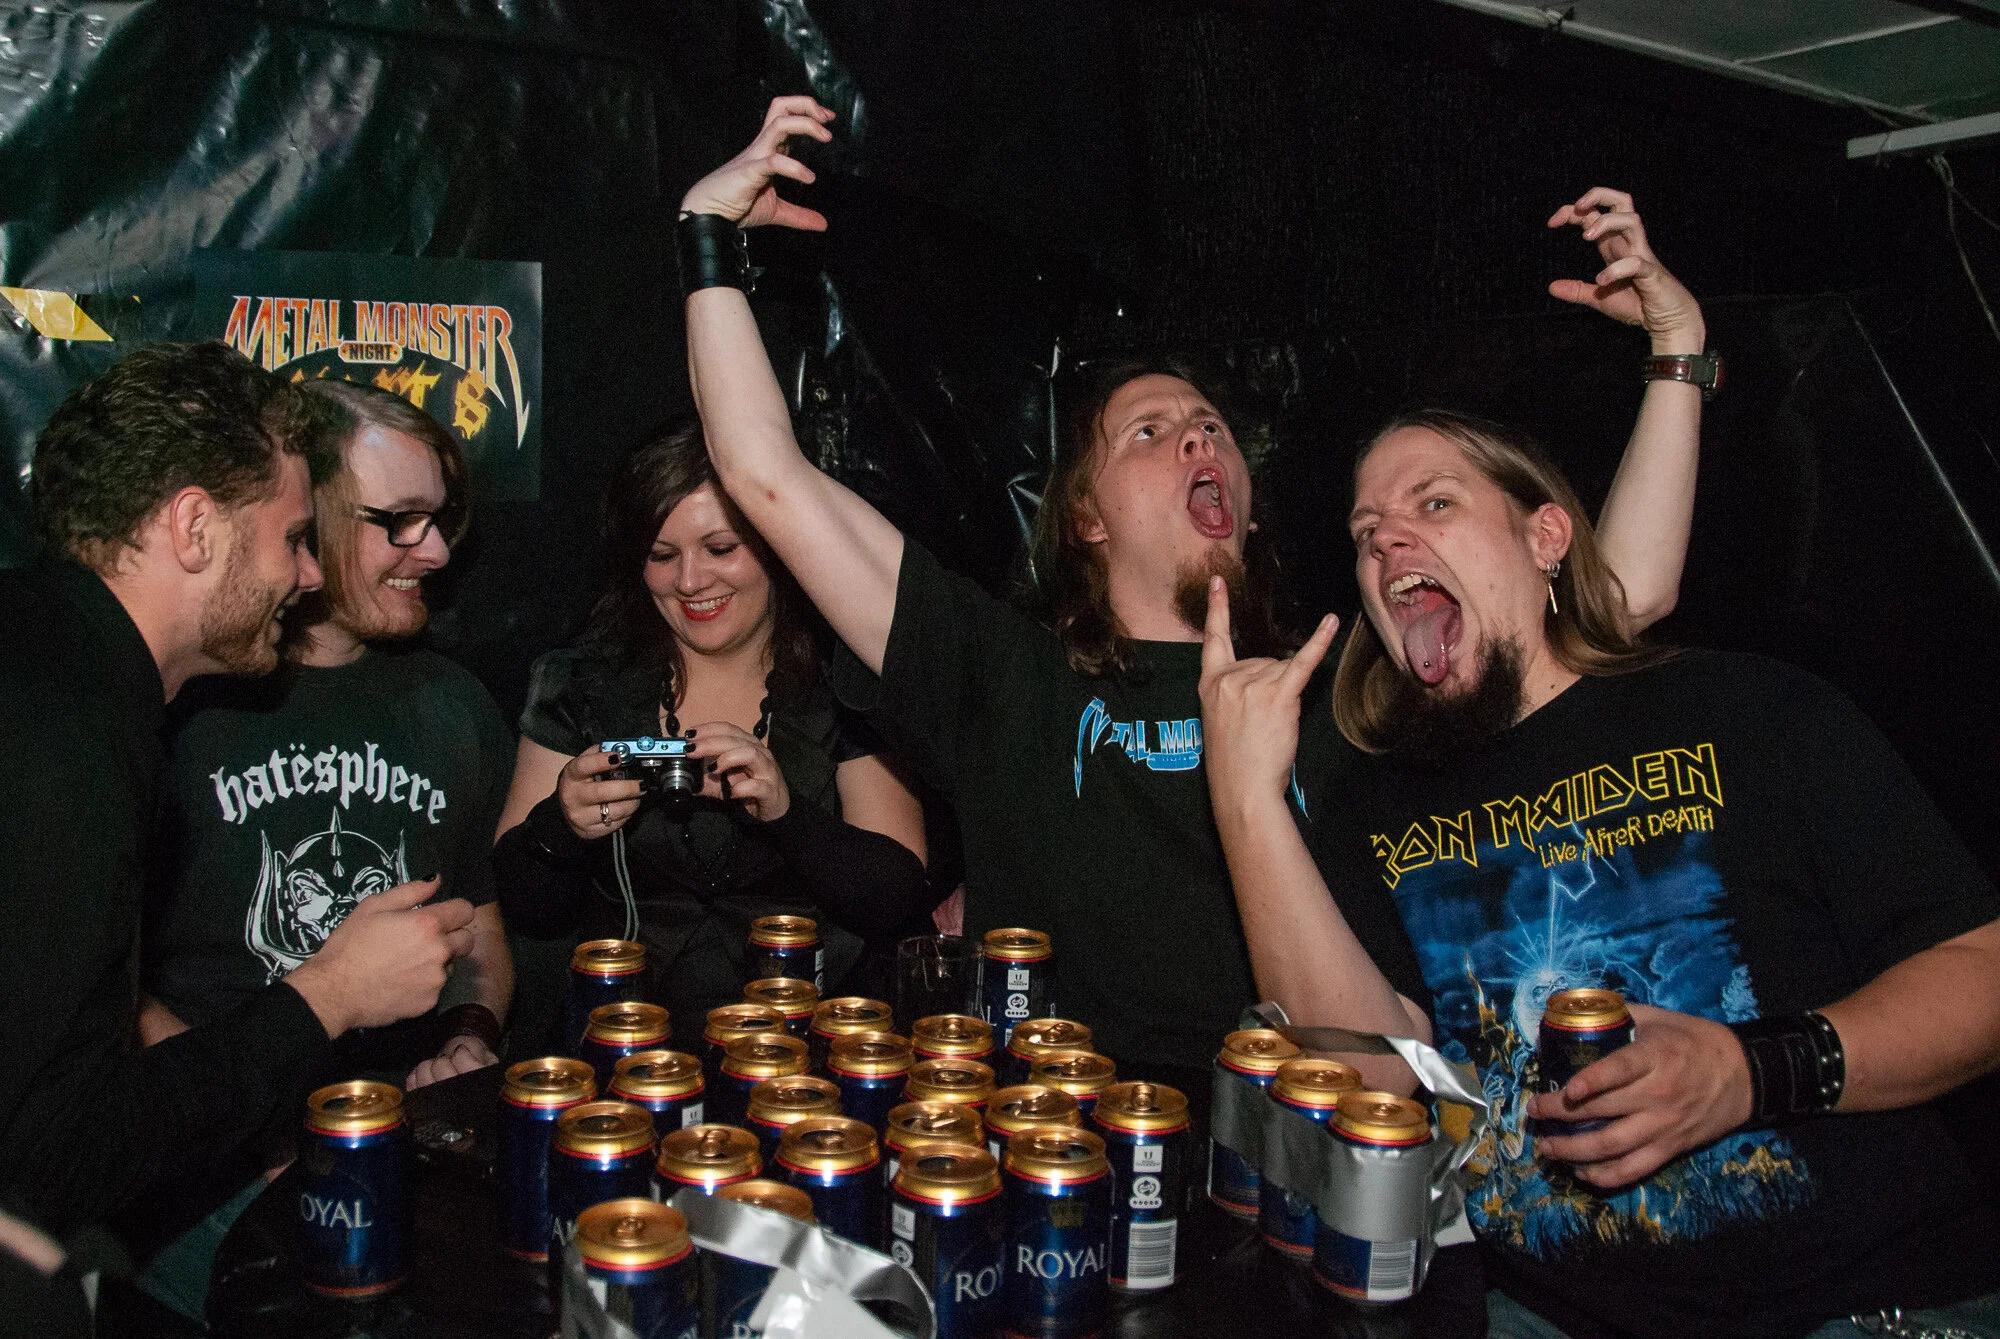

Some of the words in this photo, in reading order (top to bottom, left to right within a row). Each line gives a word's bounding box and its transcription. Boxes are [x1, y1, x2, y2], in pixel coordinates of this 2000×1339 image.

[224, 295, 344, 373] METAL
[352, 300, 530, 450] MONSTER
[349, 342, 394, 361] NIGHT
[1481, 742, 1724, 852] MAIDEN
[300, 1193, 373, 1229] OYAL
